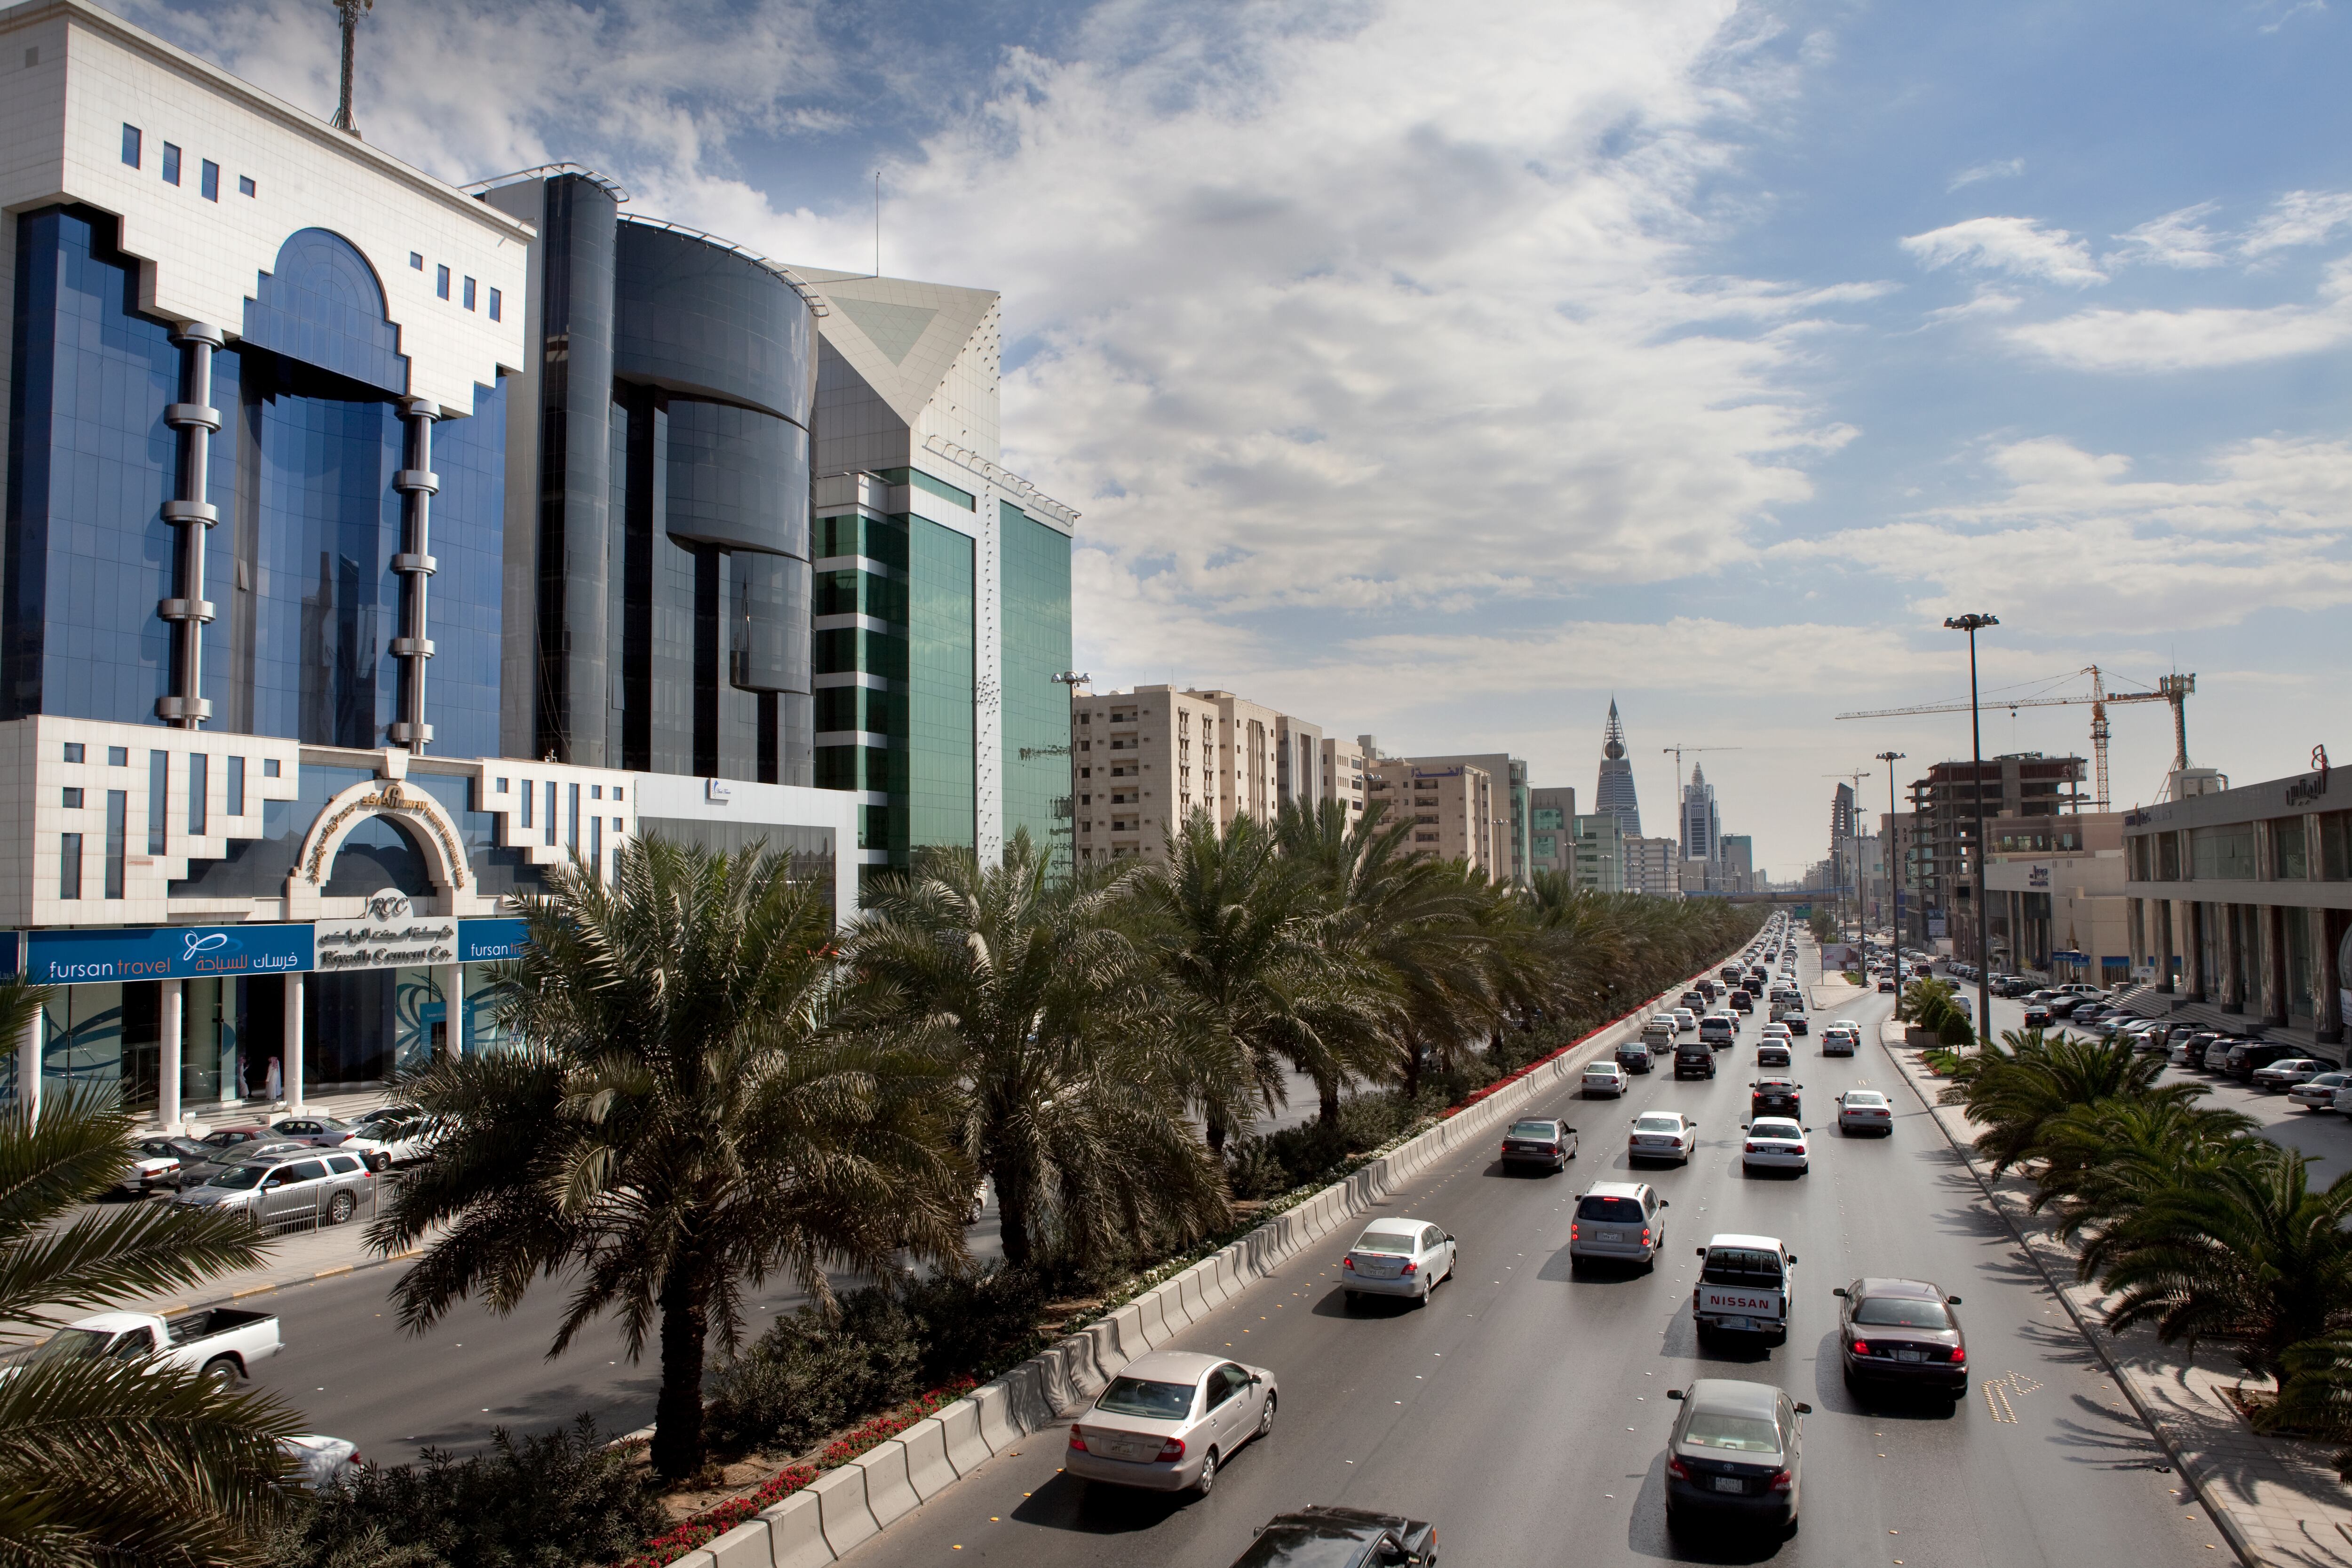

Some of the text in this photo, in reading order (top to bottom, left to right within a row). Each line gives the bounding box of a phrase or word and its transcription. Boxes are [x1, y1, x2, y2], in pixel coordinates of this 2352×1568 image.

[371, 897, 408, 917] RCC
[322, 945, 453, 967] Riyadh Cement Co.
[471, 943, 508, 956] fursan
[50, 957, 170, 978] fursan travel
[196, 952, 298, 973] فرسان للسياحة
[1710, 1296, 1769, 1309] NISSAN
